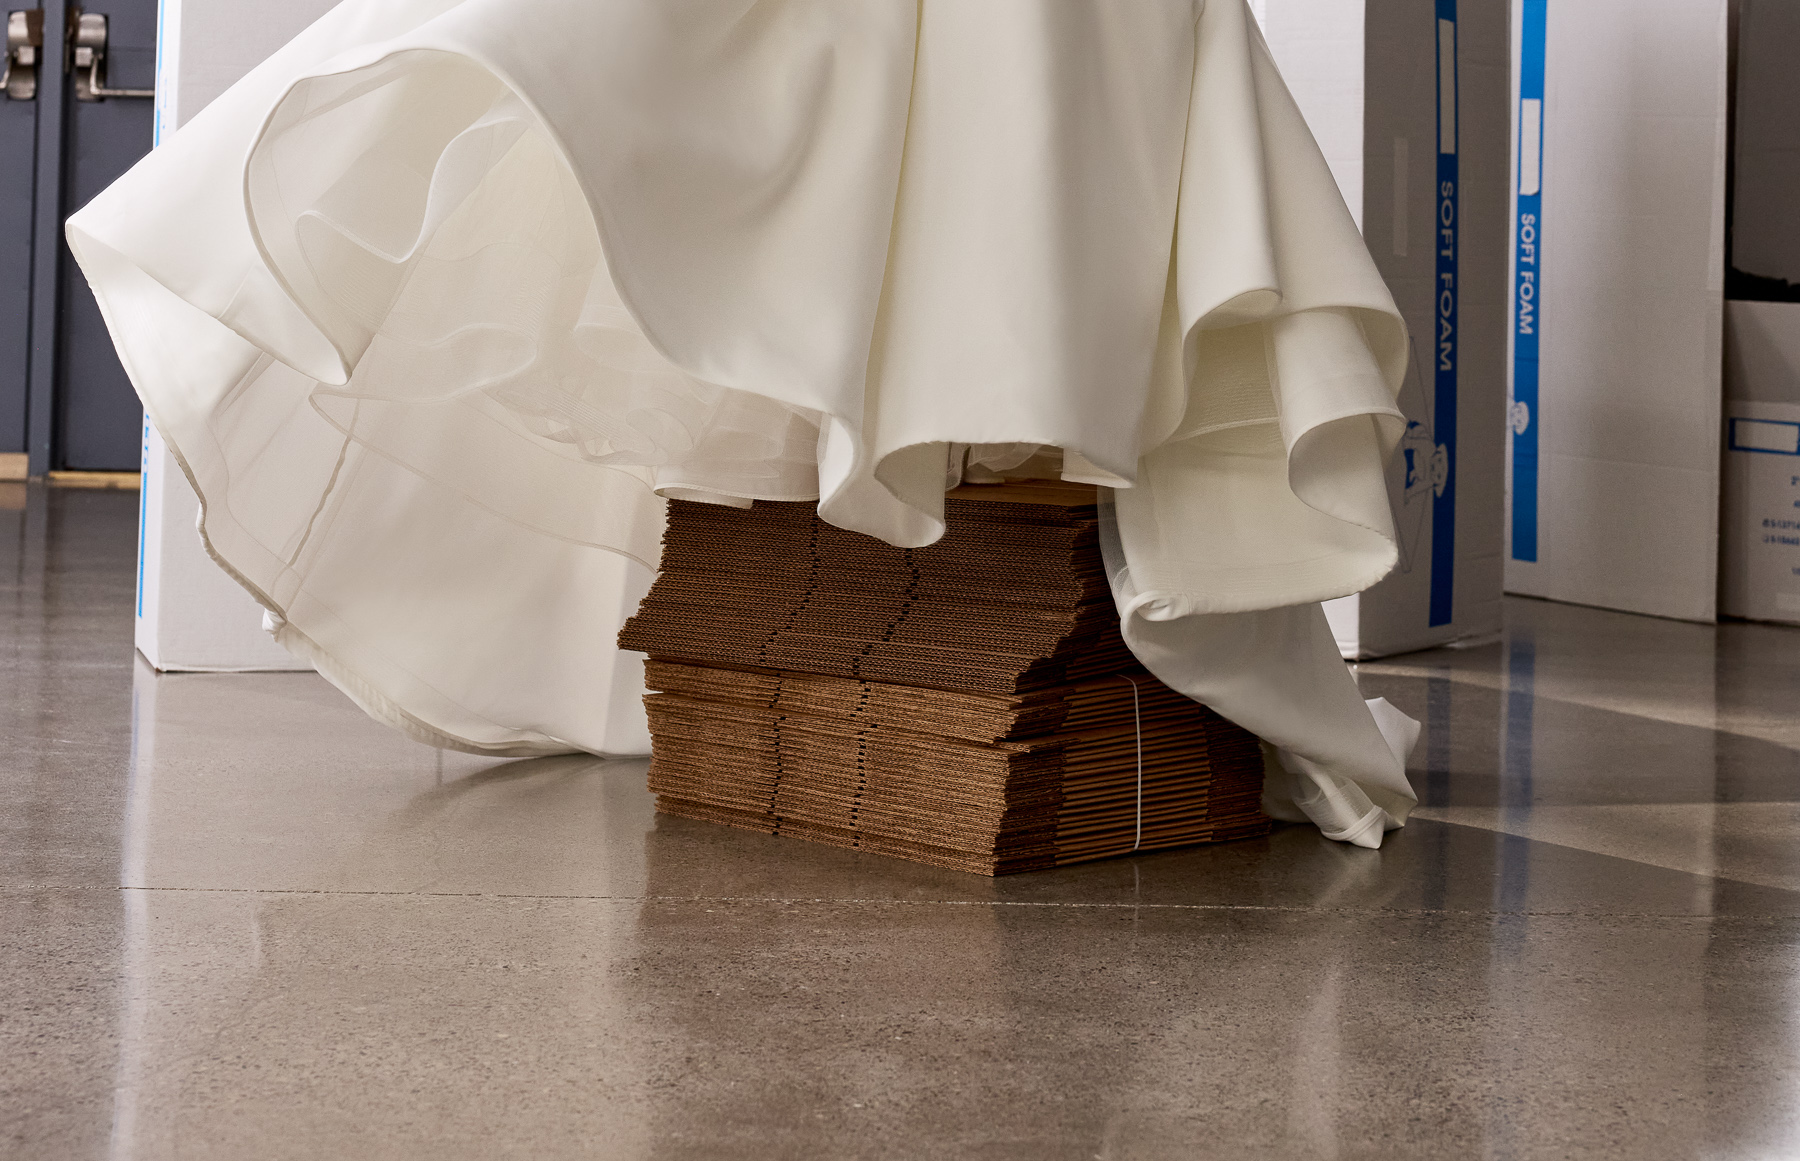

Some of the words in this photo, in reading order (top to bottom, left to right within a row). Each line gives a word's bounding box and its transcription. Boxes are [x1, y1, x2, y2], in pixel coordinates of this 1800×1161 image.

[1441, 181, 1454, 261] SOFT
[1520, 213, 1536, 265] SOFT
[1440, 272, 1453, 371] FOAM
[1519, 271, 1534, 335] FOAM
